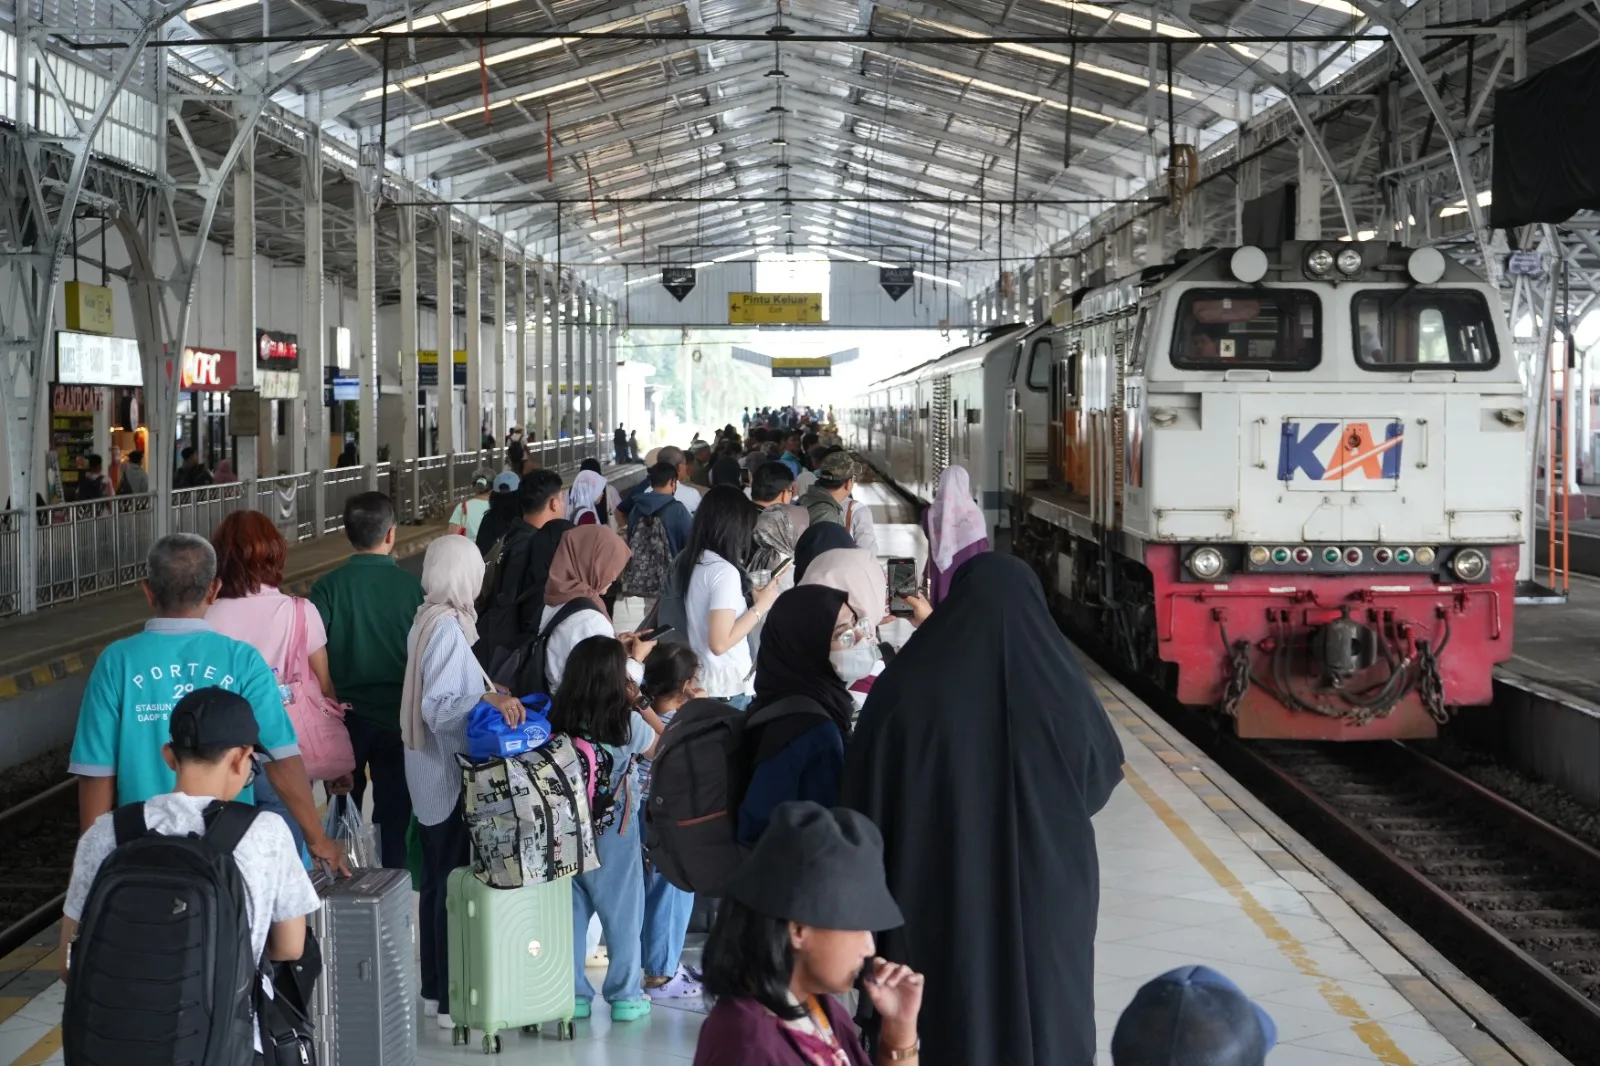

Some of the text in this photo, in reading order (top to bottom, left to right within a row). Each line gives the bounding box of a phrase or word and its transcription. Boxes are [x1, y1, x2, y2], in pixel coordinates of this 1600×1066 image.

[676, 287, 683, 295] 1
[891, 286, 900, 295] 2
[743, 295, 808, 304] Pintu Keluar
[193, 352, 221, 384] CFC
[54, 385, 82, 411] GRAND
[1277, 422, 1405, 480] KAI
[132, 663, 234, 690] PORTER
[136, 703, 172, 712] STASIUN
[138, 714, 160, 722] DAOP
